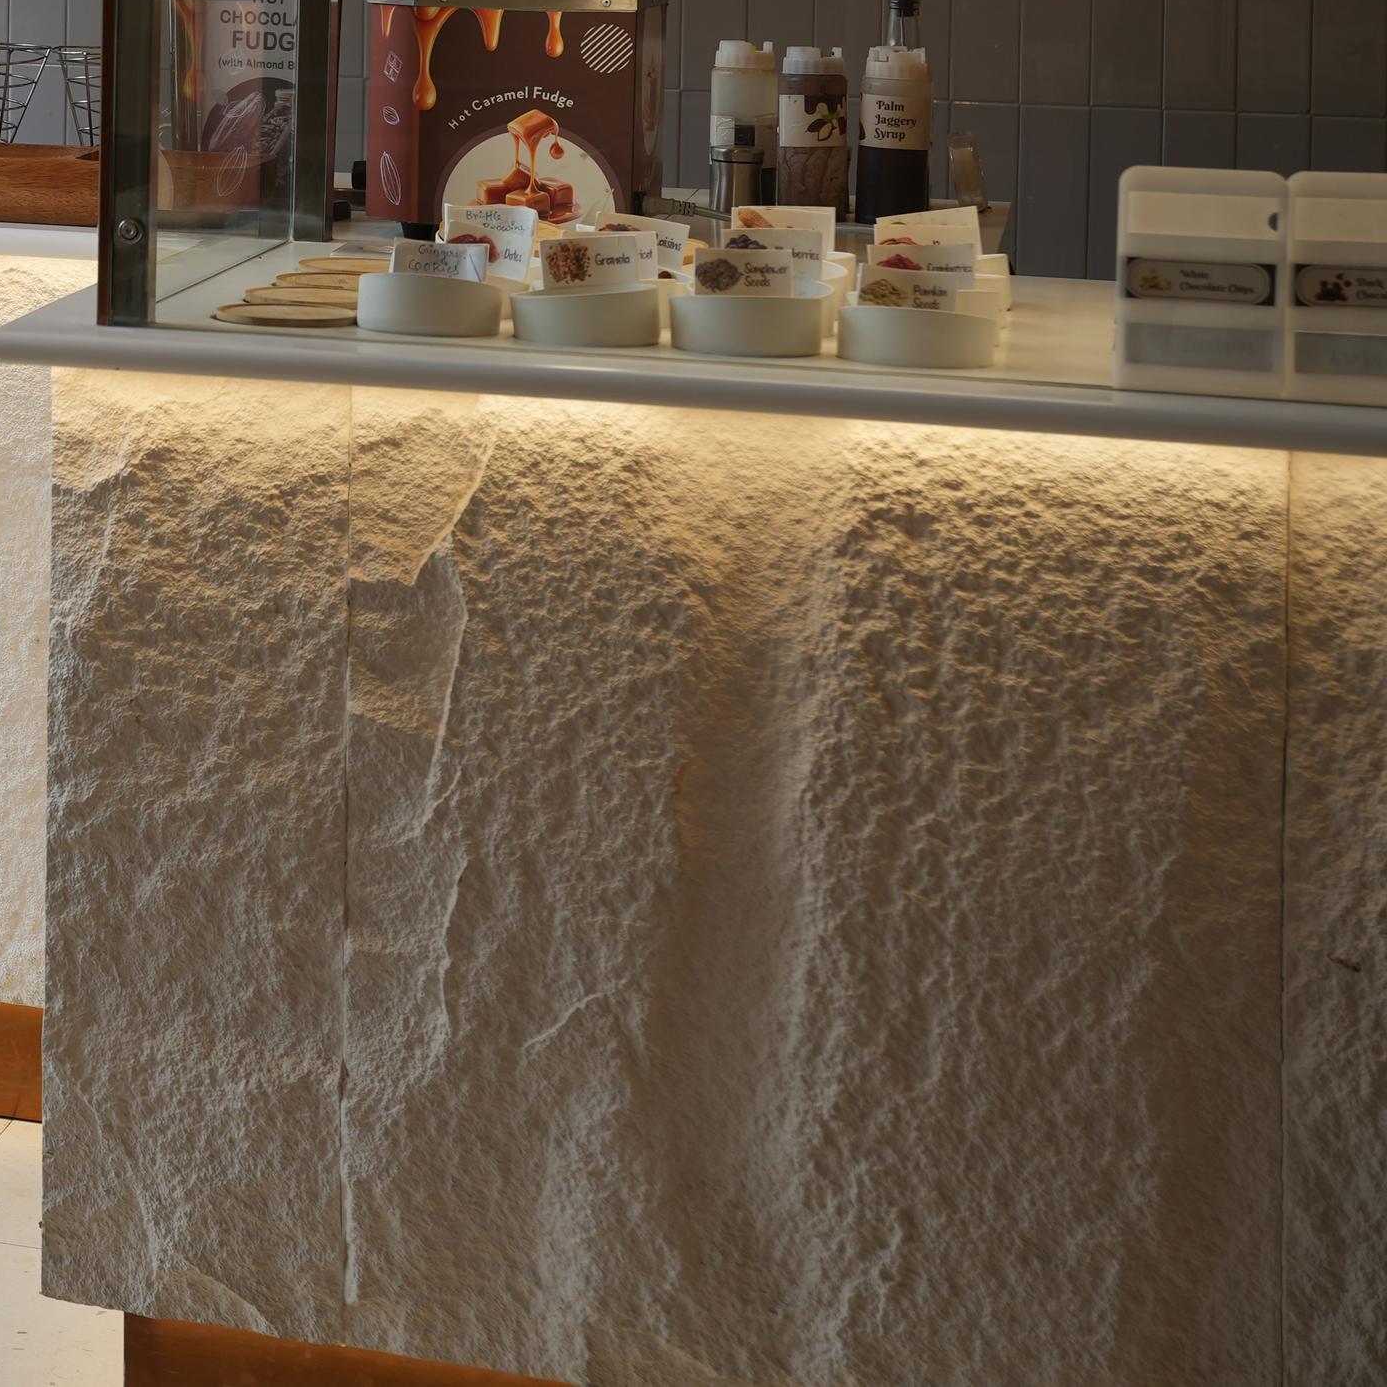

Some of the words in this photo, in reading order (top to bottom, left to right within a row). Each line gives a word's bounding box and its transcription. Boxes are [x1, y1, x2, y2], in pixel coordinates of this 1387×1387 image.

[218, 57, 243, 70] (with
[247, 58, 284, 70] Almond
[448, 109, 472, 129] Hot
[472, 86, 528, 110] Caramel
[533, 86, 574, 108] Fudge
[876, 100, 905, 112] Palm
[875, 114, 917, 128] Jaggery
[874, 128, 906, 142] Syrup
